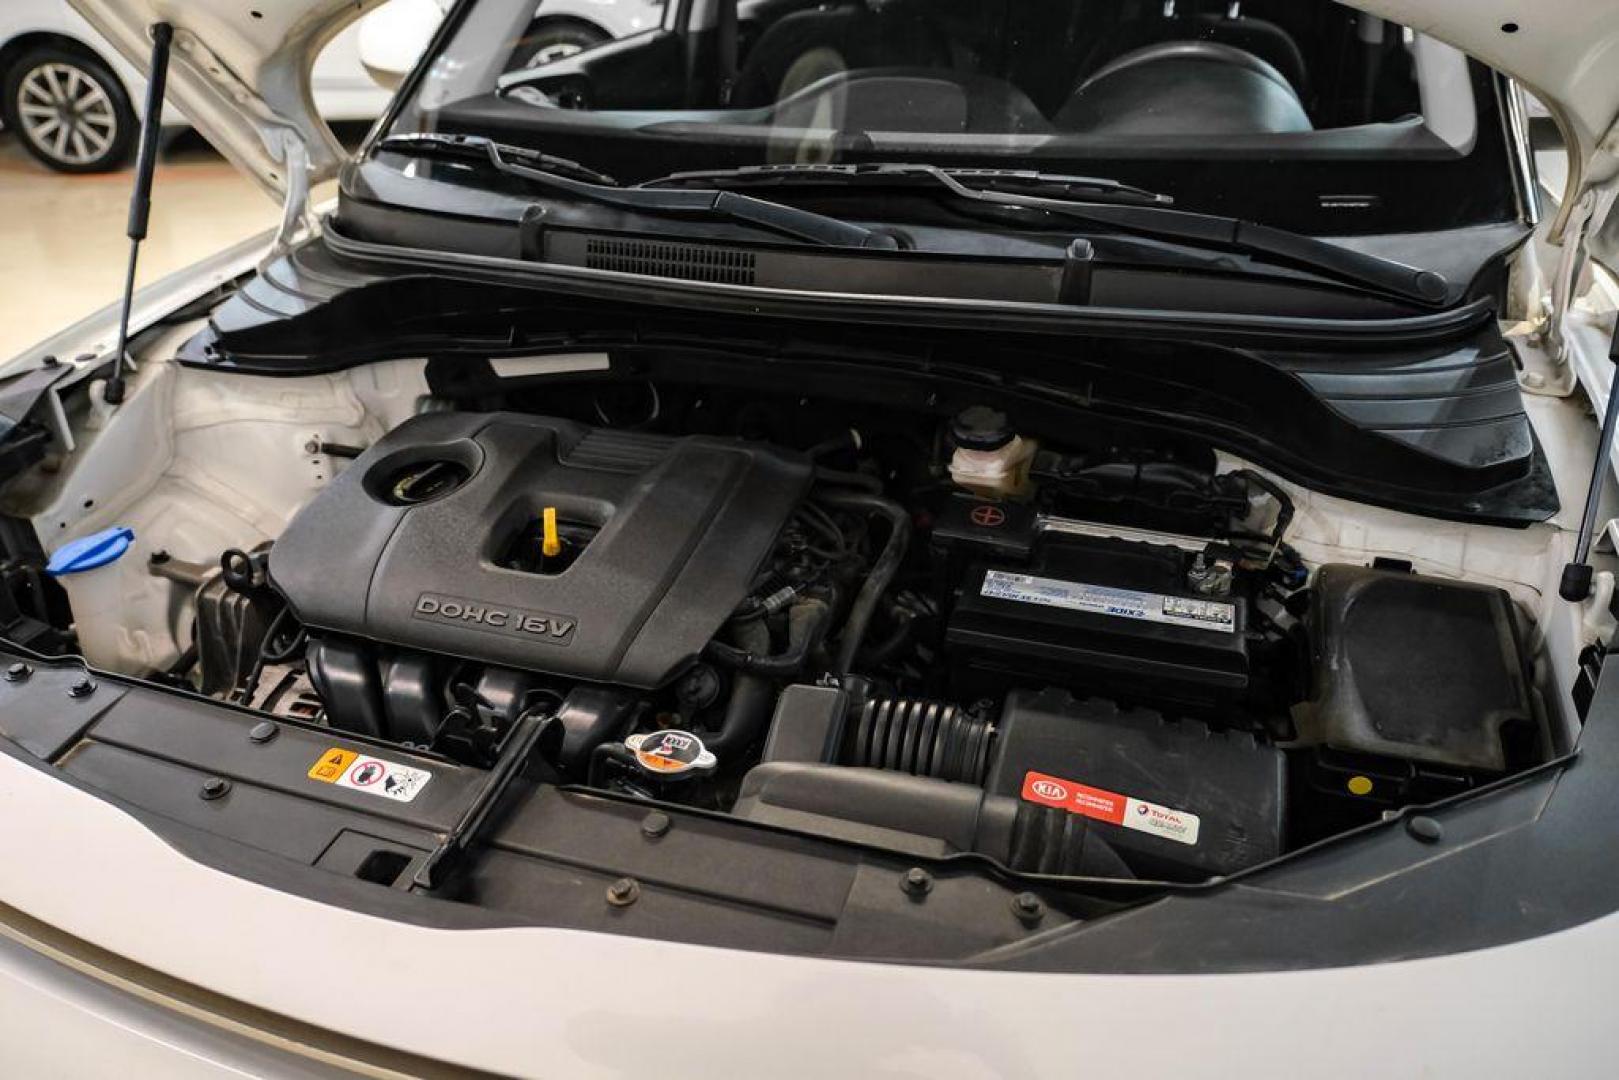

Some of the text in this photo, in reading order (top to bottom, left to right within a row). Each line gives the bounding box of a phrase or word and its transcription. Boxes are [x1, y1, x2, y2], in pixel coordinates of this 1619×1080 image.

[416, 597, 574, 637] DOHC 16V
[1037, 783, 1062, 798] KIA
[1150, 809, 1182, 825] TOTAL
